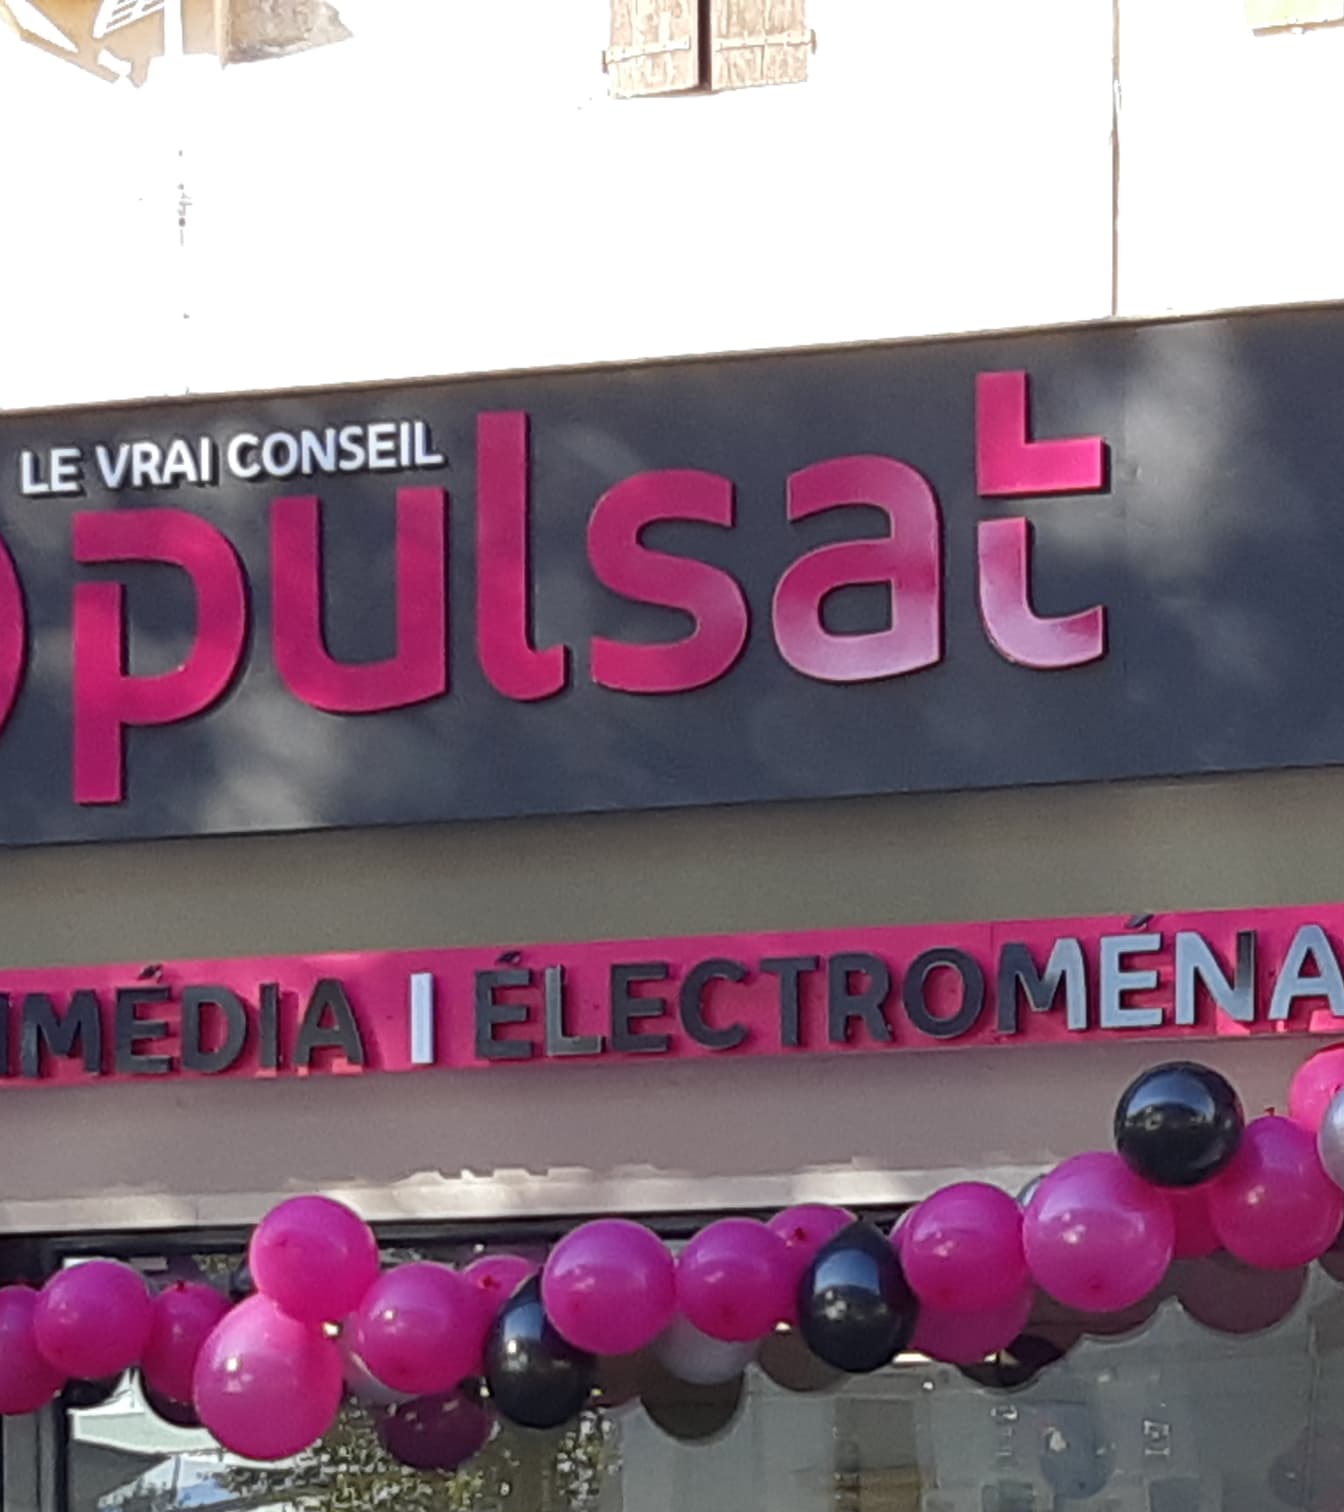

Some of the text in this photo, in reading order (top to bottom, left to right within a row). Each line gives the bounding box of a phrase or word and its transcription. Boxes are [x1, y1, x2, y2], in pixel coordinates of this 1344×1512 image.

[20, 421, 444, 495] LE VRAI CONSEIL
[70, 370, 1109, 806] pulsat
